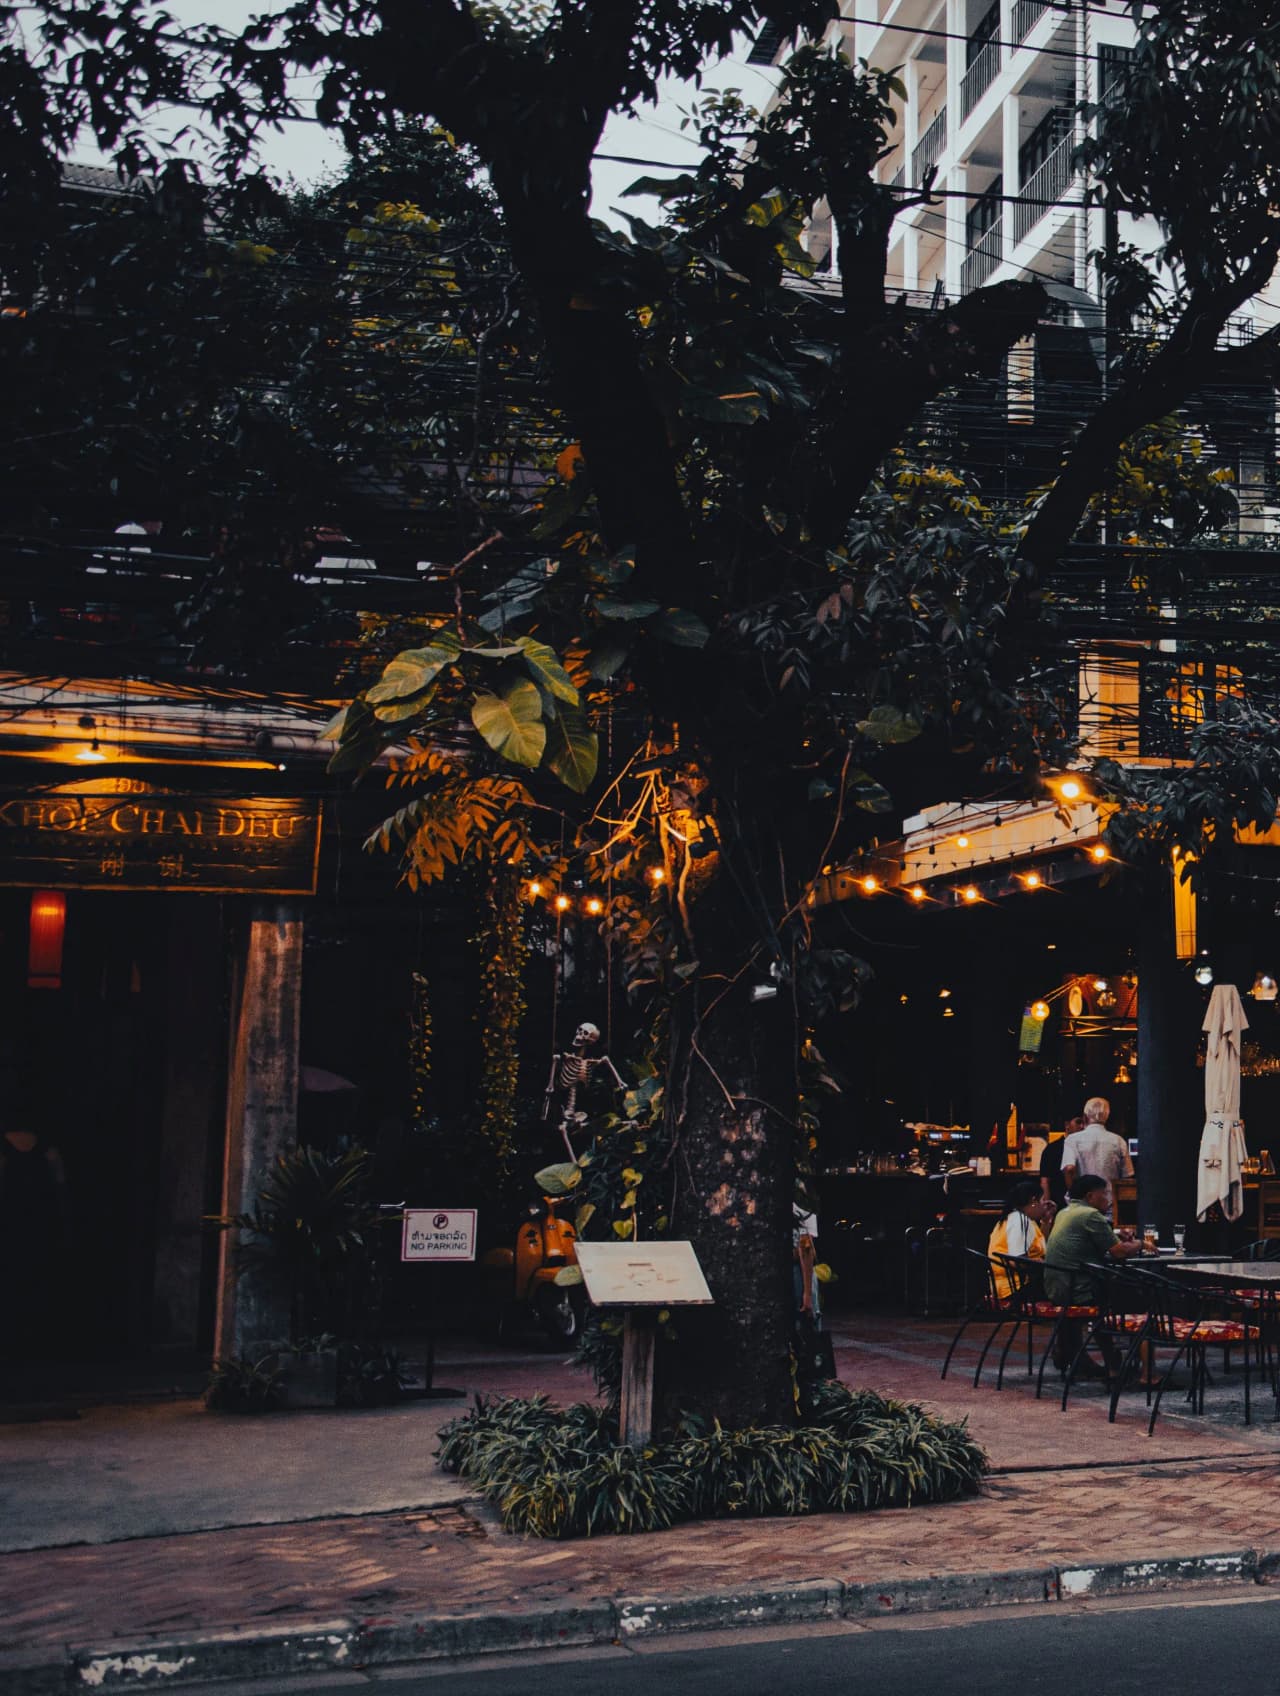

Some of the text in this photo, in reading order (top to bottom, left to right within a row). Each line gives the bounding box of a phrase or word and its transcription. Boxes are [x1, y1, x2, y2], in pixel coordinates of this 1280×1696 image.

[109, 804, 203, 836] CHAI
[217, 808, 299, 839] DEU
[411, 1242, 467, 1250] NO PARKING
